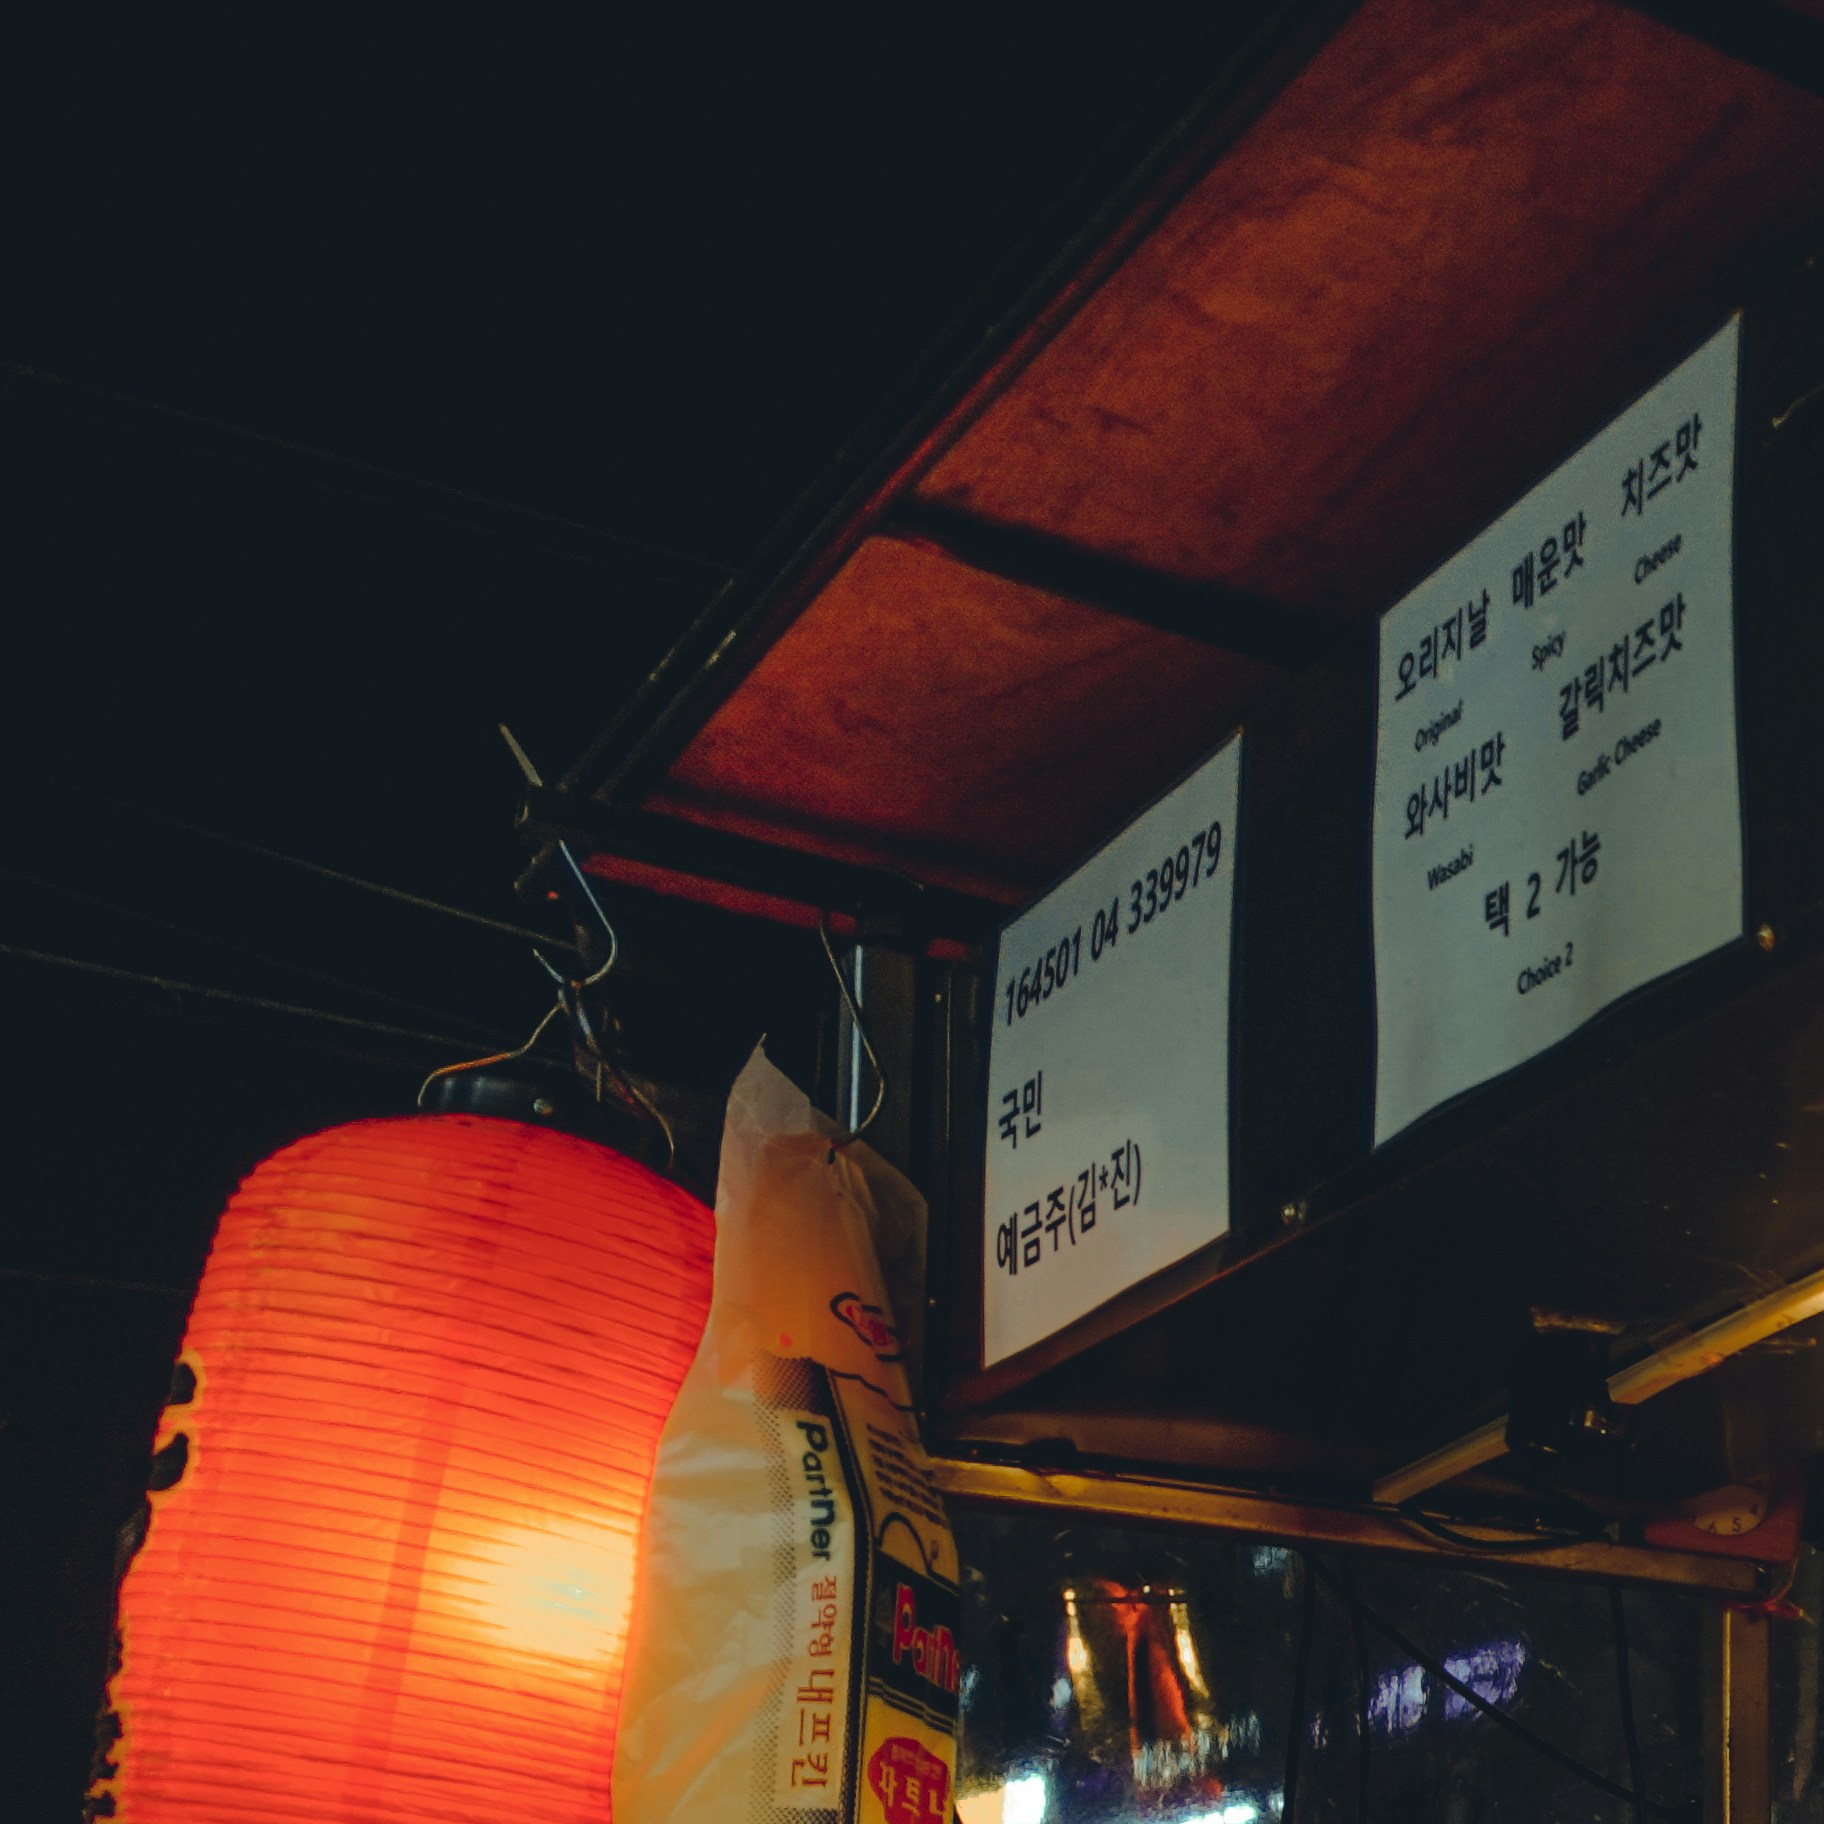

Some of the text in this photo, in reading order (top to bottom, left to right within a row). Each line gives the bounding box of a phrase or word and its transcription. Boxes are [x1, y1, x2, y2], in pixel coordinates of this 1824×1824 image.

[1395, 413, 1702, 702] 오리지날 매운맛 치즈맛
[1404, 593, 1686, 839] 와사비맛 갈릭치즈맛
[1415, 534, 1682, 752] Original Spicy Cheese
[1428, 717, 1662, 890] Wasabi Garlic Cheese
[1006, 821, 1222, 1026] 164501 04 339979
[1485, 831, 1601, 938] 택 2 가능
[1517, 942, 1573, 996] Choice 2
[999, 1071, 1042, 1149] 국민
[797, 1420, 836, 1561] Partner
[791, 1667, 836, 1788] 내프킨
